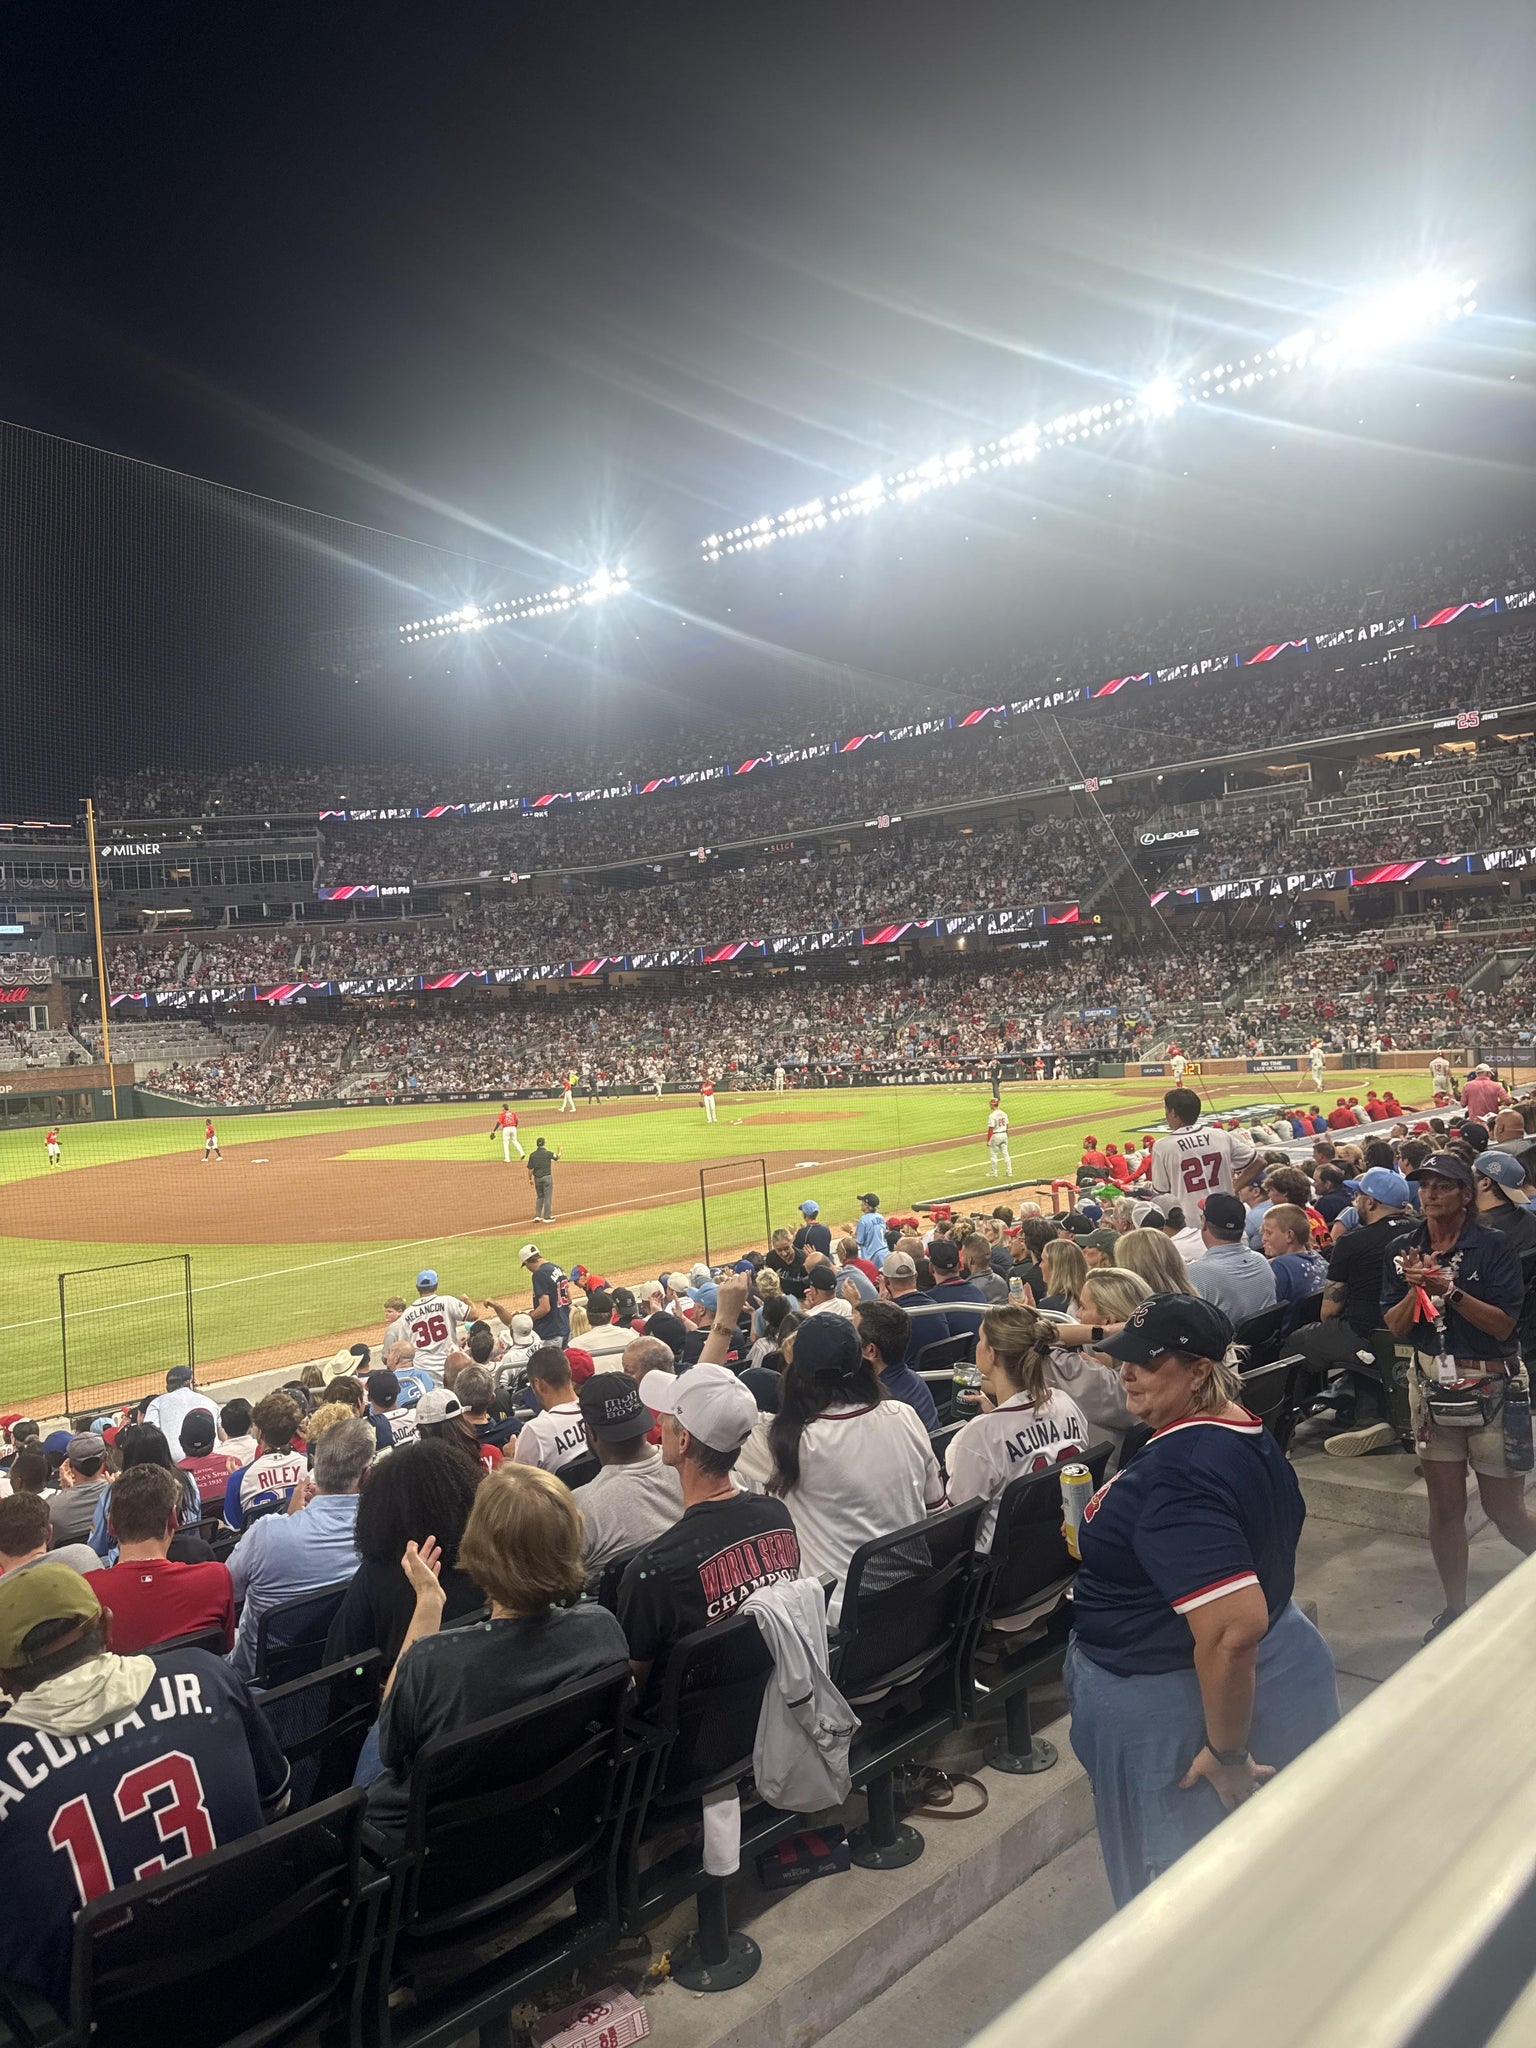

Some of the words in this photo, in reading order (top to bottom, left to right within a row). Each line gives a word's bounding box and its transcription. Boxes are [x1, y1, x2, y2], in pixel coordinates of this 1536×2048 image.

[1315, 628, 1354, 650] WHAT
[1357, 627, 1368, 641] A
[1369, 617, 1406, 639] PLAY
[1156, 664, 1189, 683] WHAT
[1190, 663, 1199, 676] A
[1200, 655, 1229, 674] PLAY
[1011, 696, 1042, 715] WHAT
[1043, 695, 1052, 709] A
[1053, 688, 1081, 706] PLAY
[889, 725, 914, 741] WHAT
[915, 724, 922, 736] A
[922, 718, 945, 735] PLAY
[1457, 710, 1480, 730] 25
[776, 750, 800, 765] WHAT
[801, 749, 808, 761] A
[809, 744, 831, 759] PLAY
[679, 771, 699, 785] WHAT
[700, 770, 706, 781] A
[706, 766, 724, 779] PLAY
[1084, 777, 1099, 793] 21
[576, 789, 602, 802] WHAT
[603, 788, 610, 798] A
[610, 786, 633, 798] PLAY
[350, 809, 378, 820] WHAT
[379, 809, 387, 819] A
[388, 808, 412, 819] PLAY
[469, 801, 492, 813] WHAT
[493, 801, 500, 811] A
[499, 798, 520, 810] PLAY
[877, 814, 890, 829] 10
[1156, 829, 1200, 841] LEXUS
[113, 843, 161, 857] MILNER
[770, 841, 795, 852] SLICE
[510, 872, 519, 884] 3
[1209, 878, 1264, 902] WHAT
[1269, 877, 1283, 896] A
[1286, 871, 1337, 893] PLAY
[398, 886, 410, 894] PM
[945, 915, 984, 934] WHAT
[987, 914, 997, 930] A
[1000, 908, 1034, 928] PLAY
[772, 936, 807, 953] WHAT
[810, 934, 820, 950] A
[821, 930, 854, 948] PLAY
[632, 953, 660, 969] WHAT
[661, 951, 669, 967] A
[670, 948, 695, 965] PLAY
[495, 967, 530, 982] WHAT
[532, 966, 540, 980] A
[540, 963, 565, 979] PLAY
[338, 980, 374, 994] WHAT
[377, 979, 385, 993] A
[387, 976, 415, 991] PLAY
[156, 990, 196, 1007] WHAT
[199, 990, 209, 1004] A
[211, 987, 246, 1003] PLAY
[1177, 1134, 1211, 1152] RILEY
[1181, 1152, 1222, 1194] 27
[405, 1302, 446, 1326] MELANCON
[411, 1315, 449, 1348] 36
[1005, 1417, 1060, 1462] ACUÑA
[258, 1466, 301, 1490] RILEY
[700, 1543, 761, 1604] WORLD
[150, 1673, 213, 1722] JR.
[47, 1750, 218, 1906] 13
